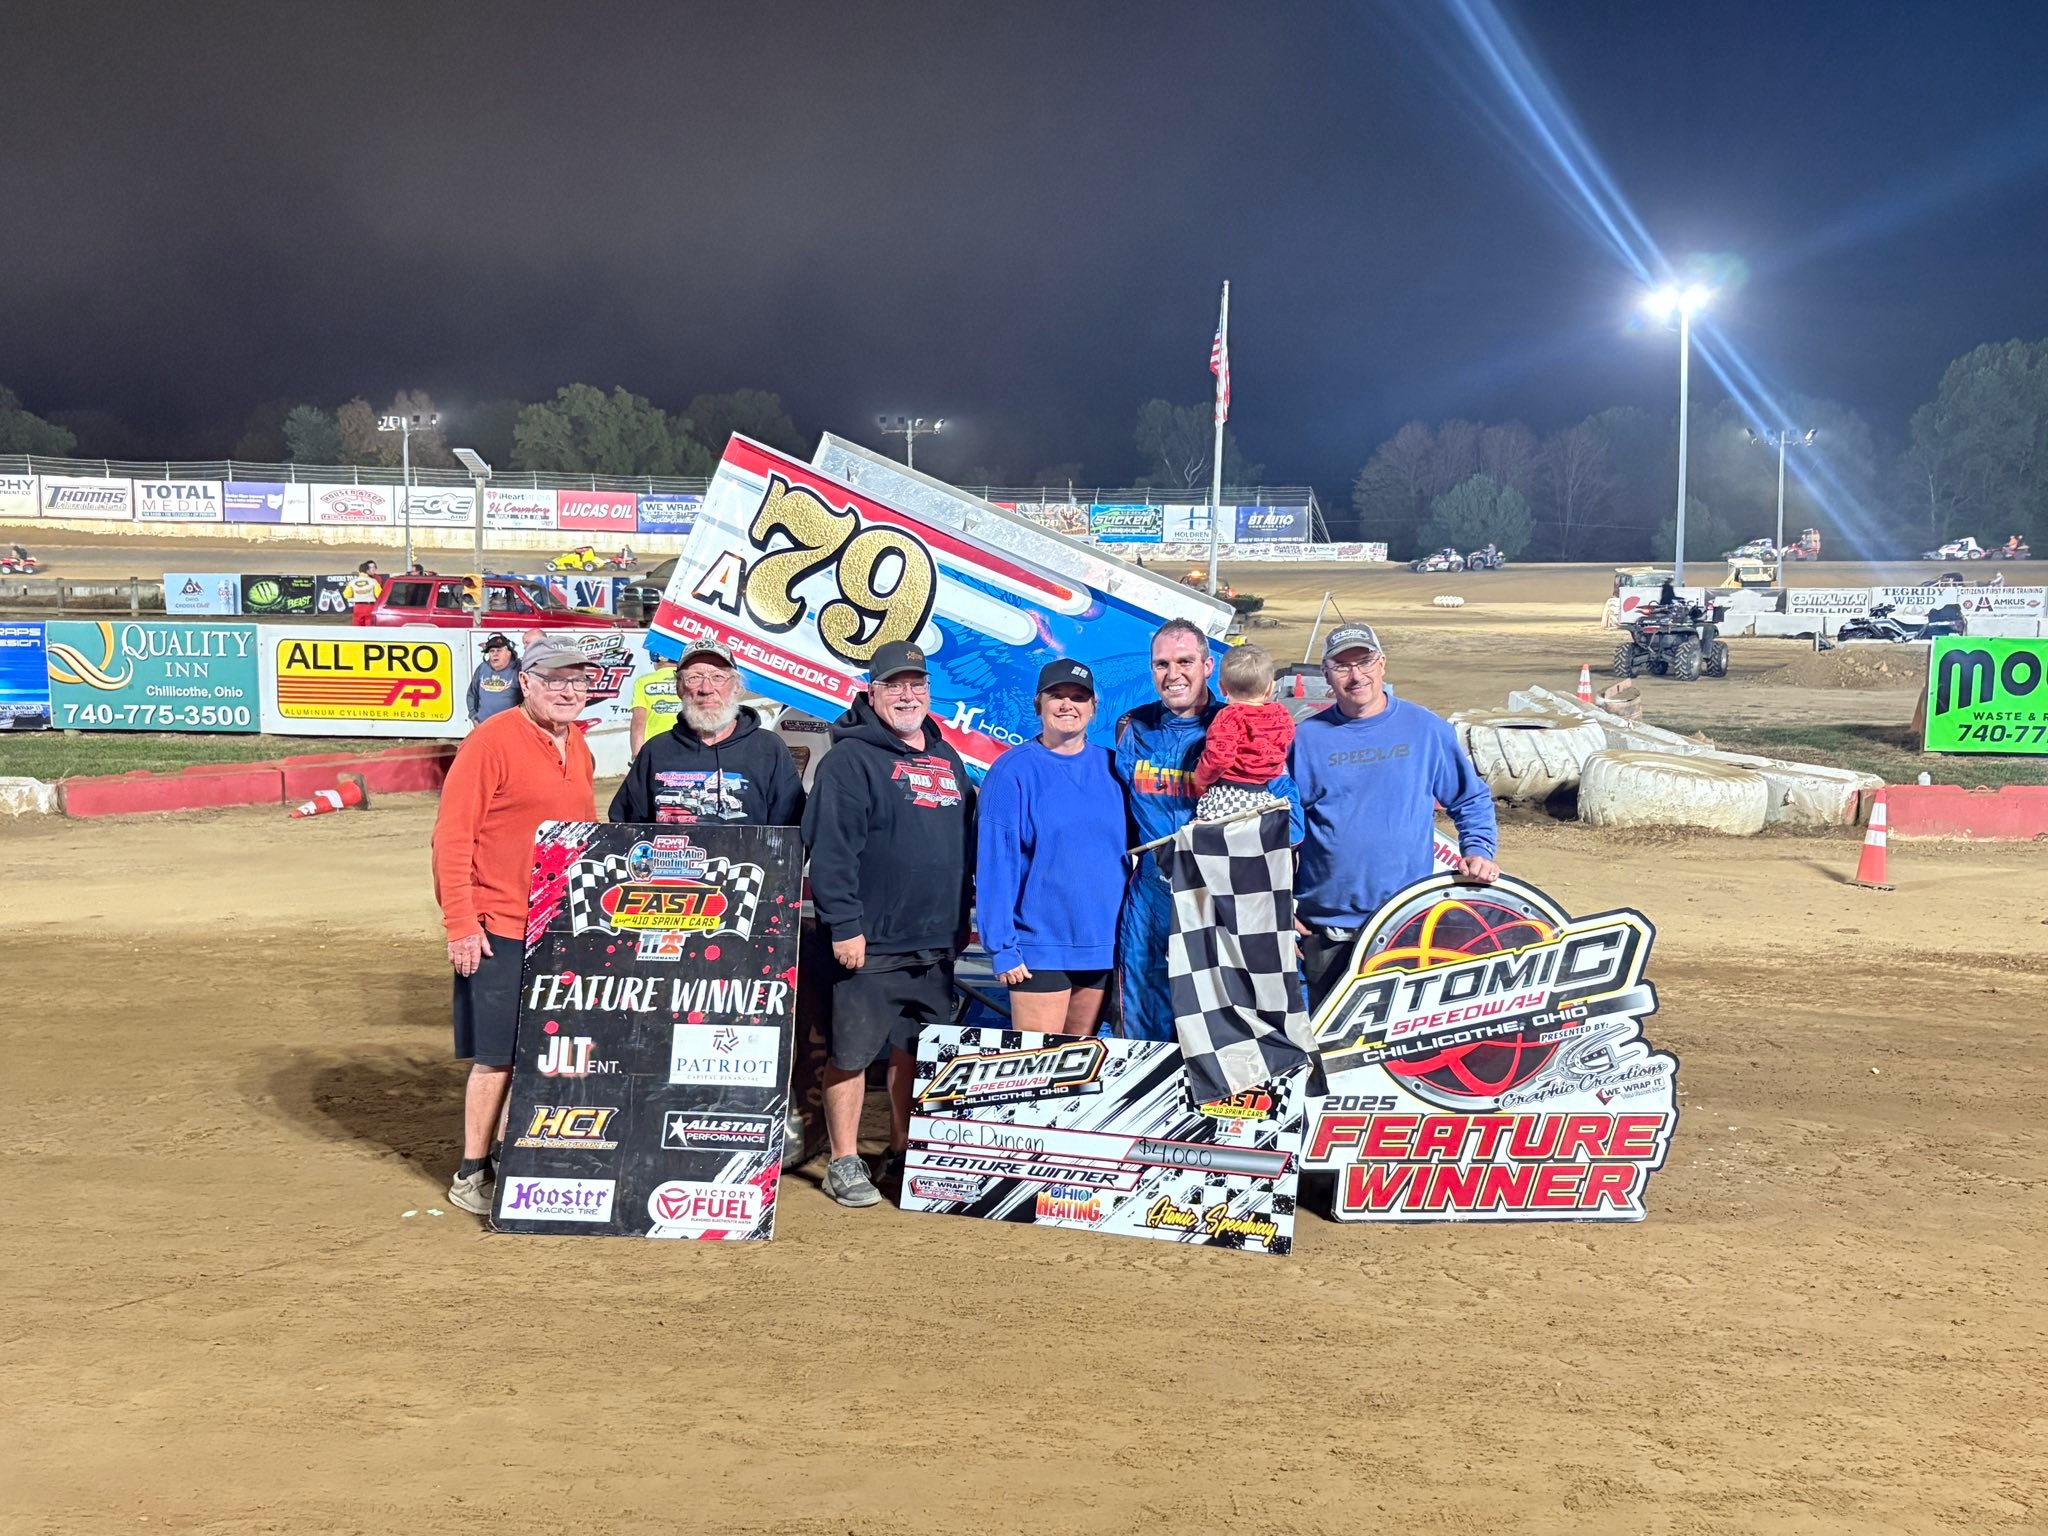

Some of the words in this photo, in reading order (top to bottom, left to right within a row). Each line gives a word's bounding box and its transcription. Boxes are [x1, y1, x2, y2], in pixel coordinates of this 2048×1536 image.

[45, 485, 126, 508] THOMAS
[141, 485, 215, 499] TOTAL
[142, 500, 216, 511] MEDIA
[504, 503, 551, 515] Country
[562, 502, 608, 518] LUCAS
[610, 503, 634, 519] OIL
[1095, 515, 1152, 526] SLICKER
[1248, 515, 1264, 525] BT
[1263, 514, 1294, 525] AUTO
[692, 551, 747, 616] A
[745, 473, 937, 666] 79
[287, 595, 312, 609] BEAST
[1882, 588, 1947, 597] TEGRIDY
[1893, 597, 1937, 605] WEED
[121, 624, 253, 660] QUALITY
[578, 635, 622, 653] TOMIC
[286, 643, 353, 670] ALL
[364, 644, 439, 672] PRO
[673, 615, 719, 640] JOHN
[727, 634, 841, 692] SHEWBROOKS
[165, 662, 209, 678] INN
[146, 686, 212, 699] Chillicothe,
[214, 686, 244, 698] Ohio
[64, 704, 250, 726] 740-775-3500
[285, 708, 335, 716] ALUMINUM
[339, 709, 389, 718] CYLINDER
[1973, 712, 2022, 721] WASTE
[2028, 712, 2036, 721] &
[1958, 724, 2048, 744] 740-77
[651, 850, 683, 859] Honest
[684, 850, 703, 859] Abe
[653, 859, 688, 869] Roofing
[616, 884, 721, 915] FAST
[632, 916, 649, 926] 410
[652, 916, 686, 926] SPRINT
[689, 917, 715, 927] CARS
[1324, 924, 1641, 1040] ATOMIC
[529, 975, 664, 1012] FEATURE
[670, 978, 789, 1016] WINNER
[1391, 991, 1545, 1036] SPEEDWAY
[1362, 1023, 1526, 1063] CHILLICOTHE,
[1532, 1006, 1588, 1027] OHIO
[1541, 1026, 1592, 1042] PRESENTED
[1594, 1022, 1609, 1031] BY:
[538, 1036, 592, 1075] JLT
[587, 1060, 623, 1075] ENT.
[676, 1057, 773, 1075] PATRIOT
[932, 1045, 1101, 1096] ATOMIC
[968, 1075, 1050, 1093] SPEEDWAY
[1501, 1082, 1577, 1110] Graphic
[1578, 1062, 1667, 1091] Creations
[1604, 1087, 1621, 1098] WE
[1622, 1081, 1652, 1093] WRAP
[1653, 1078, 1663, 1087] IT
[953, 1090, 1037, 1106] CHILLICOTHE,
[1039, 1086, 1069, 1096] OHIO
[1219, 1089, 1267, 1109] AST
[1322, 1095, 1398, 1111] 2025
[527, 1105, 618, 1141] HCI
[1225, 1108, 1246, 1116] SPRINT
[1247, 1110, 1264, 1118] CARS
[687, 1119, 769, 1133] ALLSTAR
[929, 1119, 974, 1142] Cole
[980, 1125, 1045, 1153] Duncan
[686, 1133, 766, 1144] PERFORMANCE
[1305, 1113, 1670, 1162] FEATURE
[1138, 1138, 1213, 1168] $4,000
[922, 1154, 1021, 1176] FEATURE
[1027, 1165, 1120, 1188] WINNER
[507, 1182, 609, 1209] Hoosier
[695, 1188, 755, 1199] VICTORY
[937, 1182, 964, 1190] WRAP
[1342, 1163, 1640, 1212] WINNER
[536, 1206, 576, 1214] RACING
[692, 1197, 753, 1219] FUEL
[1036, 1192, 1101, 1222] HEATING
[1146, 1195, 1199, 1228] Atomic
[1204, 1203, 1279, 1247] Speedway
